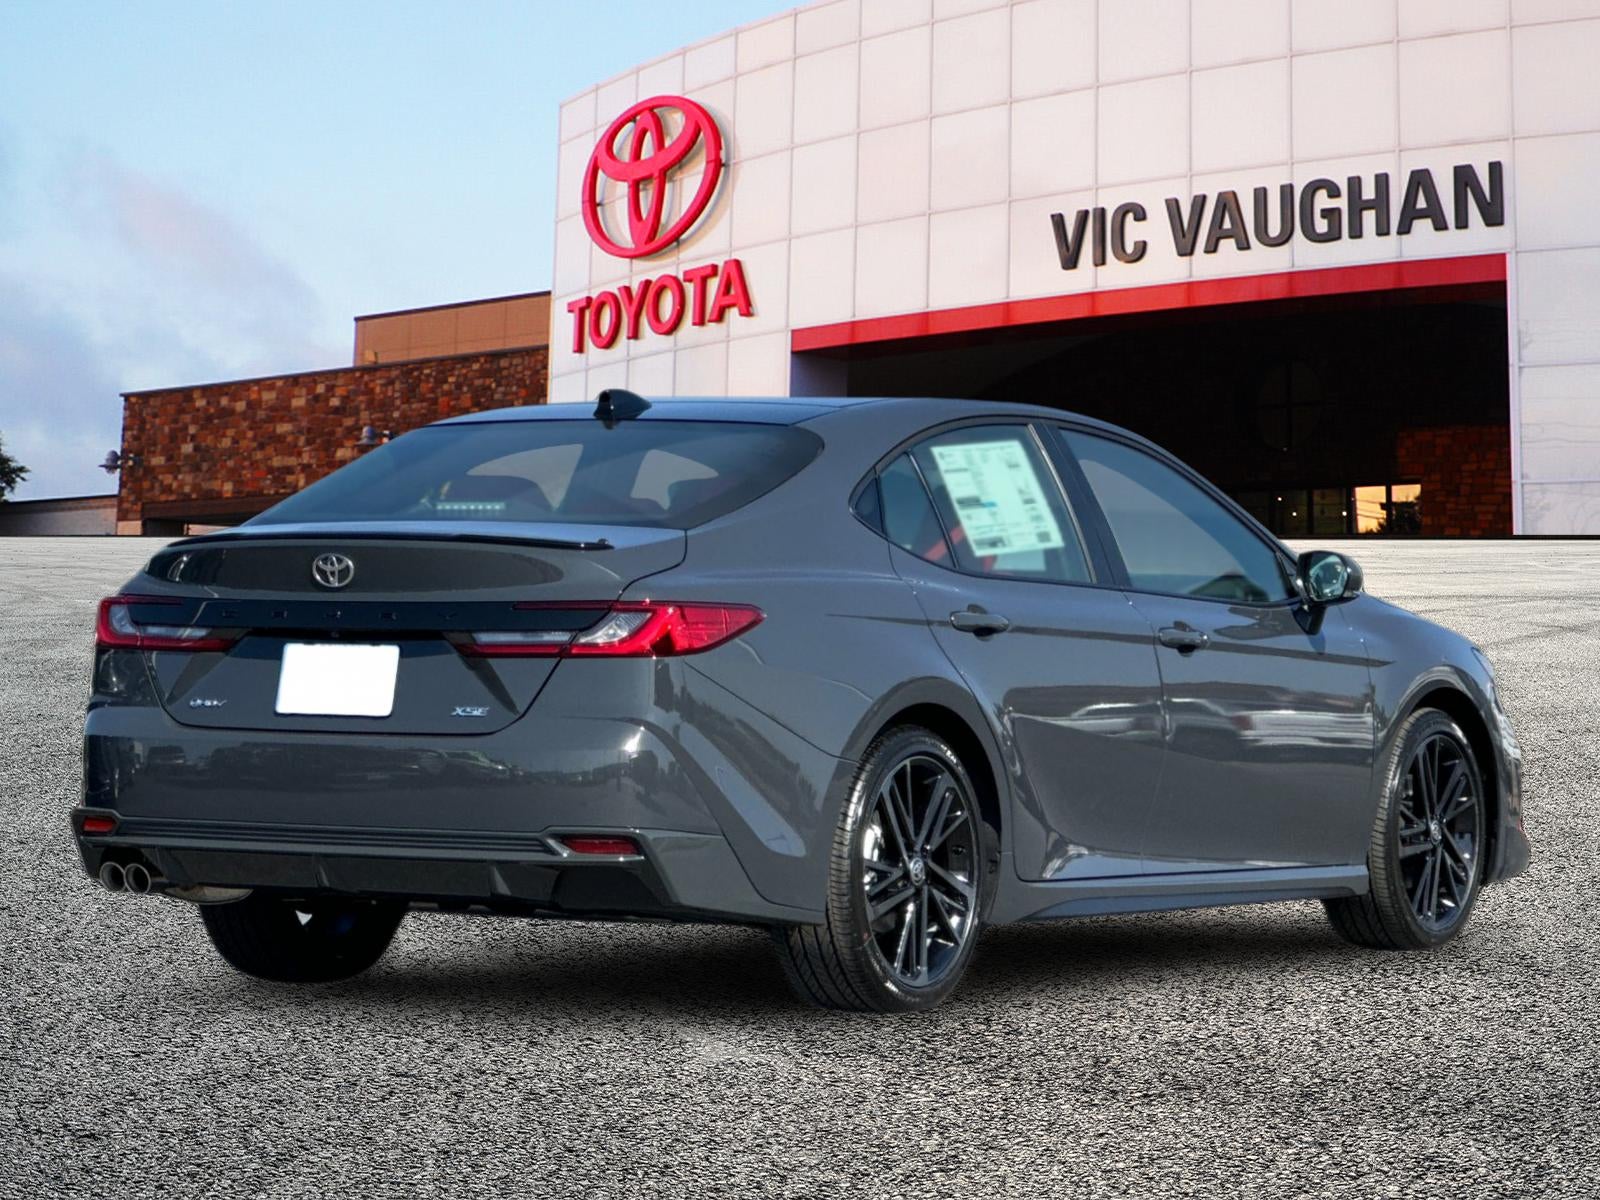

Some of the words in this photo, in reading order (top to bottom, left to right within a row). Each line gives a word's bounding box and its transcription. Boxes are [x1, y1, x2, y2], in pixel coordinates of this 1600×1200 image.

[1050, 201, 1148, 271] VIC
[1165, 160, 1505, 258] VAUGHAN
[567, 258, 754, 354] TOYOTA
